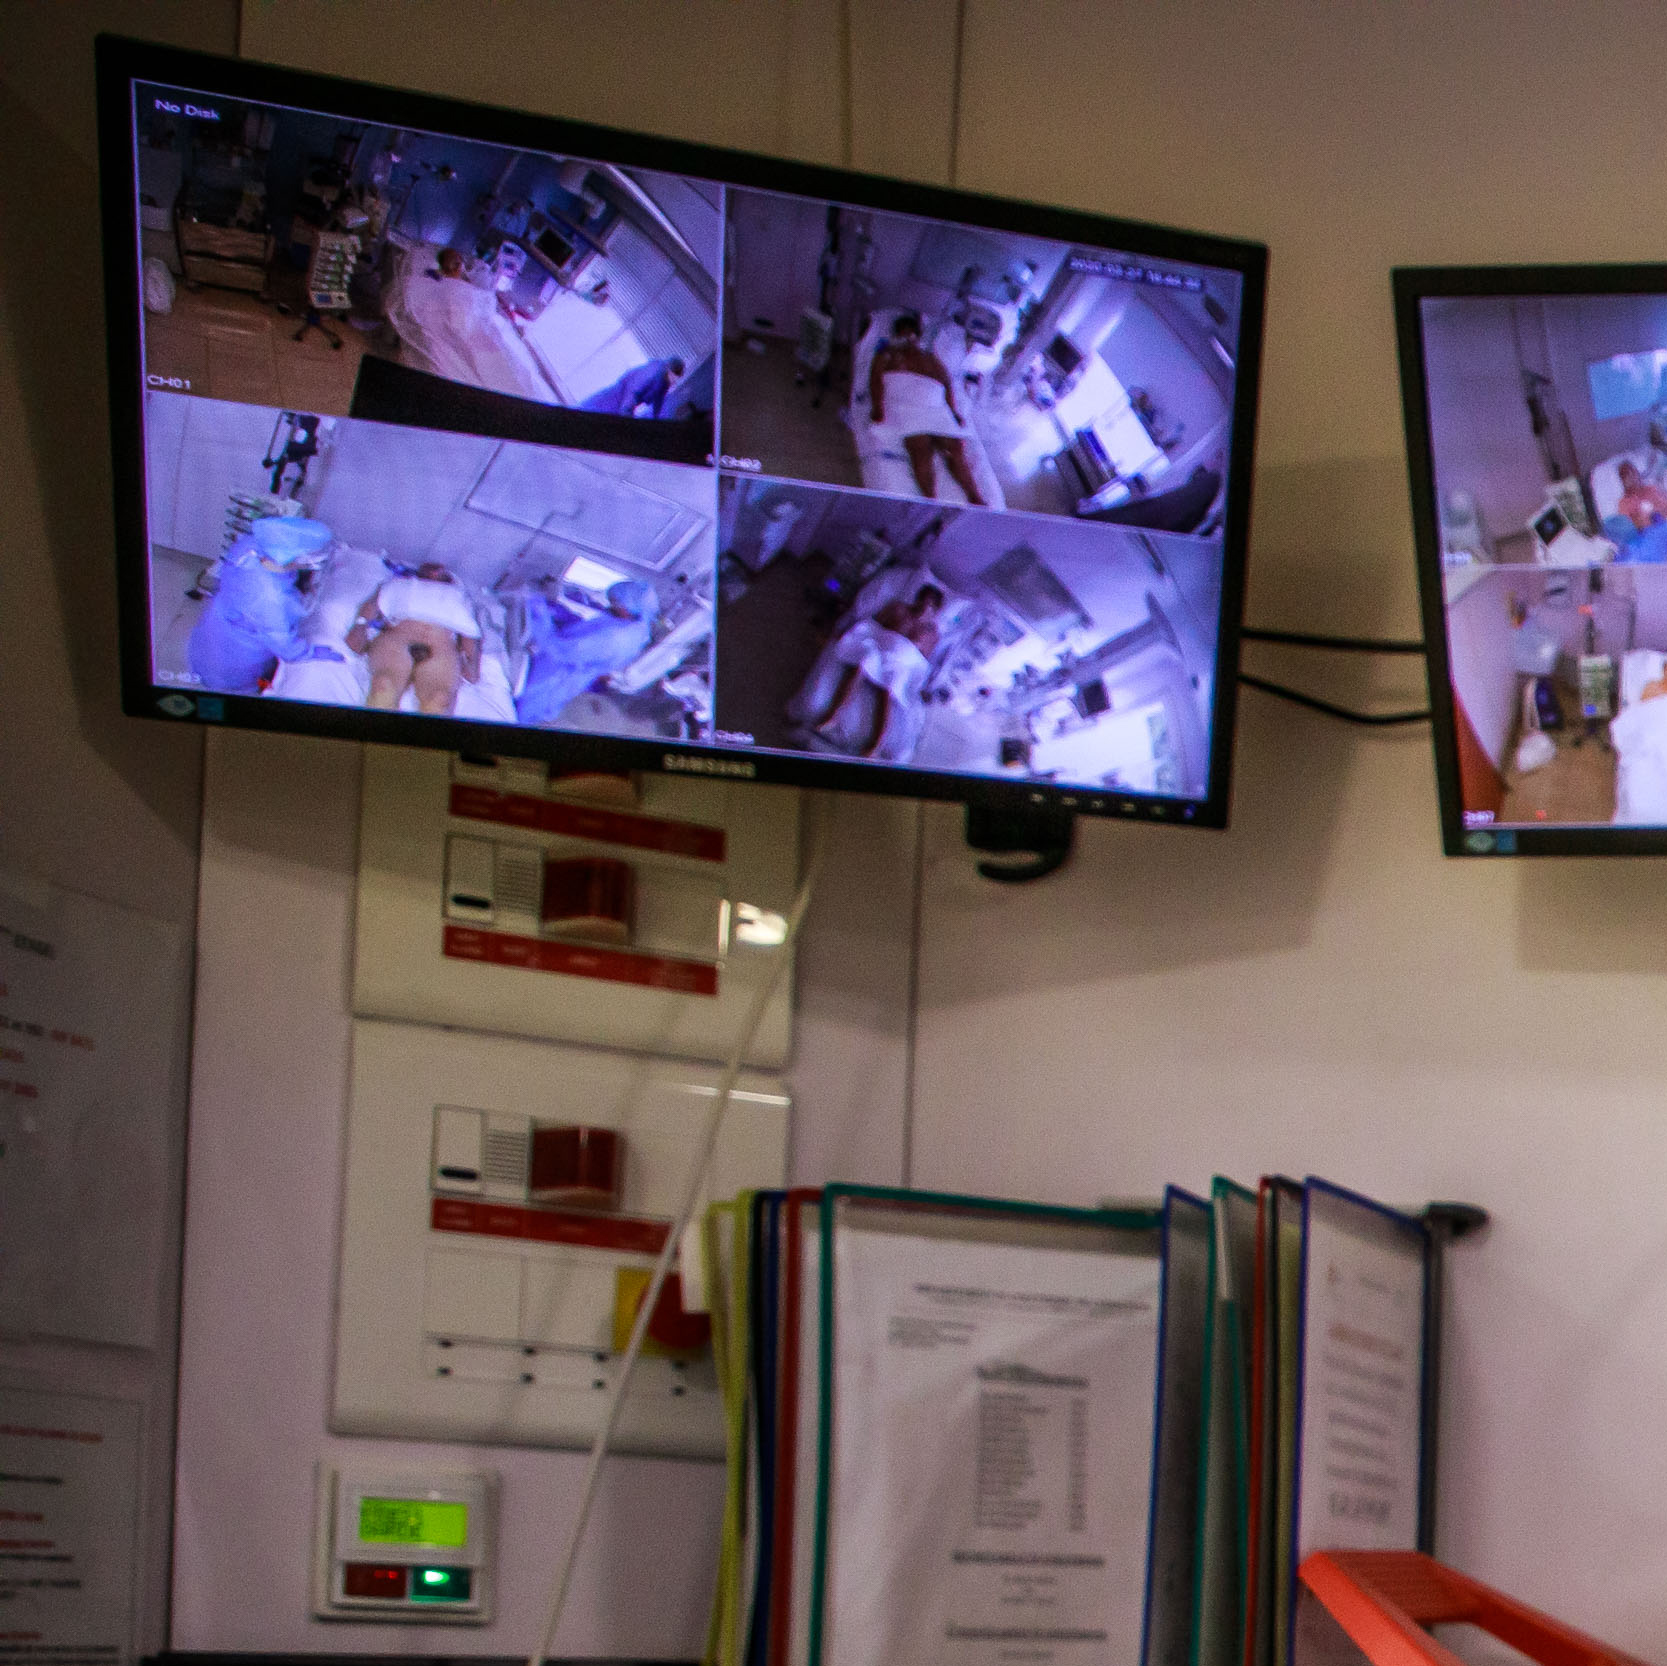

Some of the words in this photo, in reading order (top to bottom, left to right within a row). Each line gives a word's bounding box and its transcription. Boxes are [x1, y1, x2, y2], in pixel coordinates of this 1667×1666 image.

[154, 99, 181, 114] No
[185, 103, 220, 120] Disk
[147, 374, 191, 390] CH01
[663, 753, 756, 778] SAMSUNG
